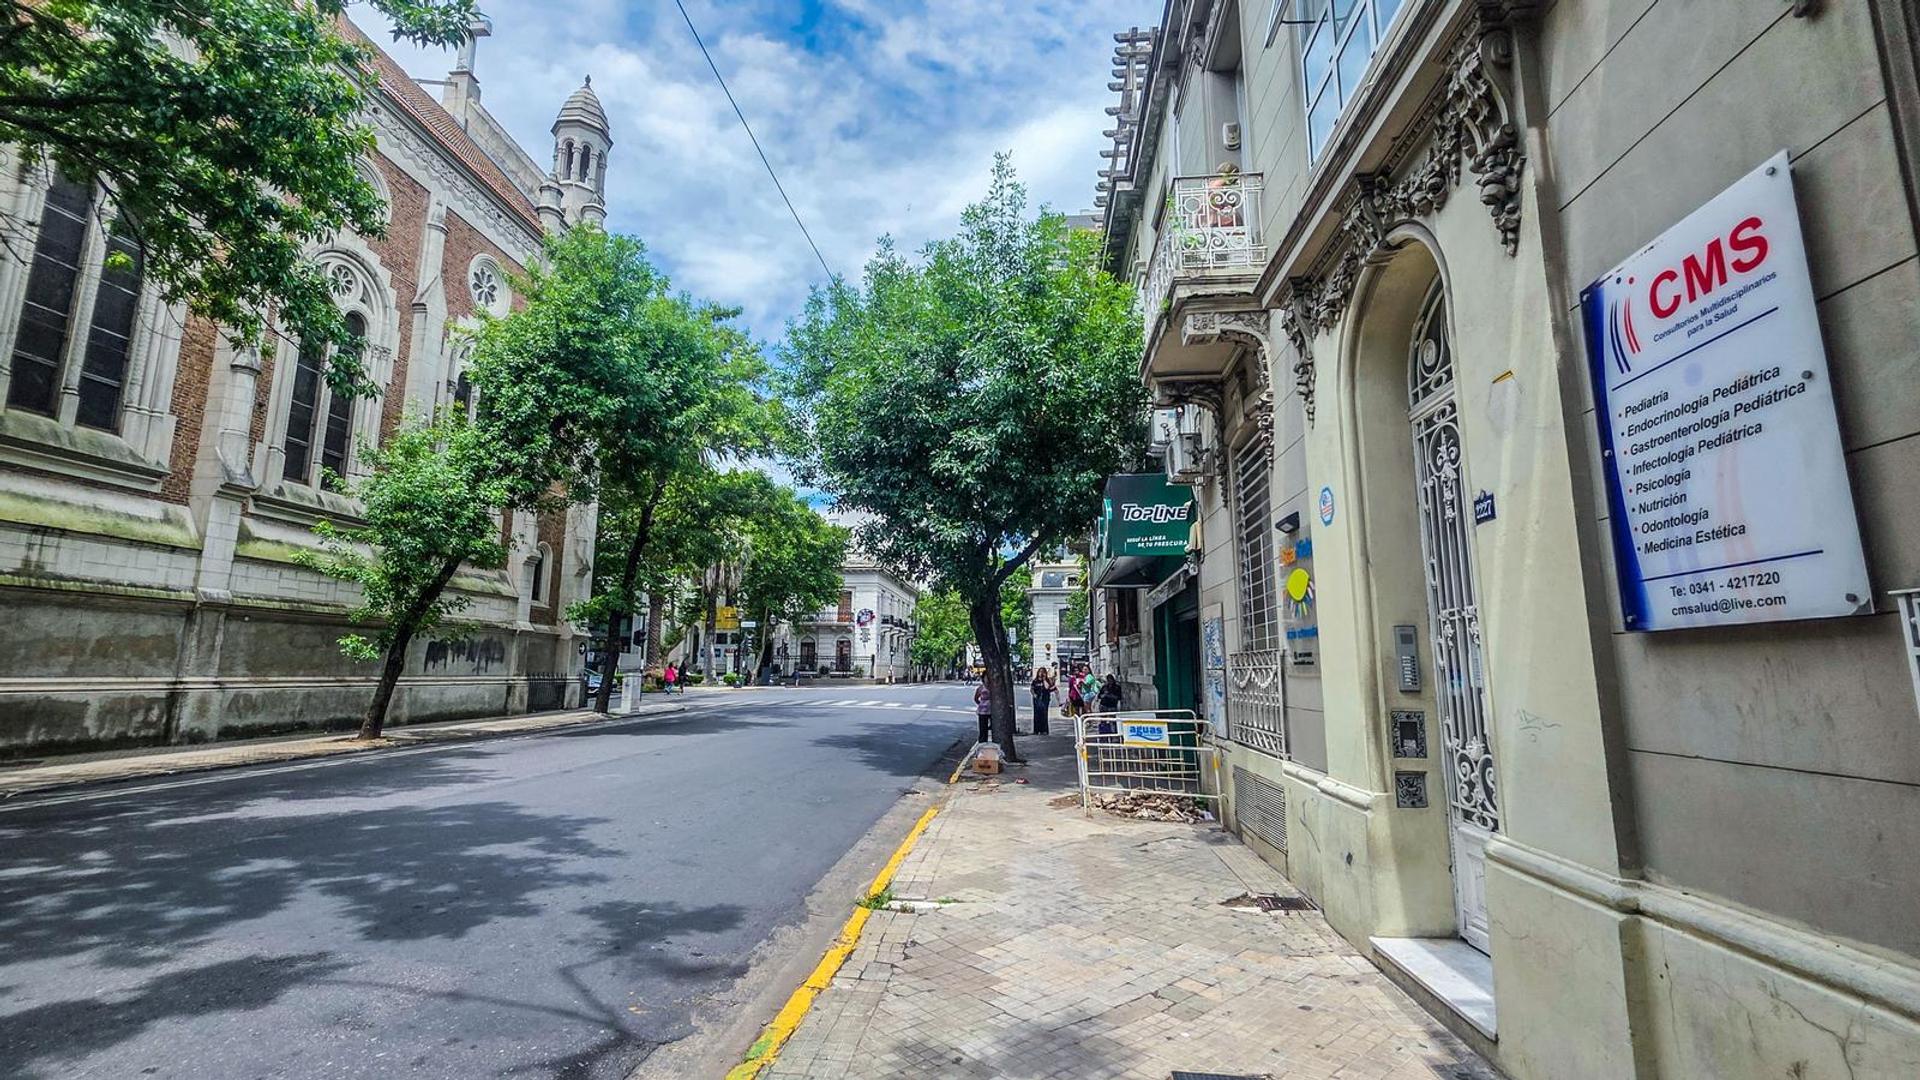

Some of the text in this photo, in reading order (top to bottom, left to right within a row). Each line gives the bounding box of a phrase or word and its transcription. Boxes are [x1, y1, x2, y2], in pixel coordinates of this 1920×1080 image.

[1649, 216, 1769, 319] CMS
[1653, 271, 1777, 342] Consultorios Multidisciplinarios
[1687, 303, 1738, 338] para la Salud
[1712, 366, 1780, 402] Pediátrica
[1630, 382, 1806, 456] Gastroenterología Pediátrica
[1698, 422, 1762, 453] Pediátrica
[1635, 469, 1691, 495] Psicología
[1638, 492, 1687, 515] Nutrición
[1641, 508, 1709, 534] Odontología
[1643, 524, 1746, 555] Medicina Estética
[1689, 581, 1715, 594] 0341
[1727, 571, 1780, 590] 4217220
[1671, 595, 1786, 617] cmsalud@live.com
[1129, 725, 1163, 736] aguas
